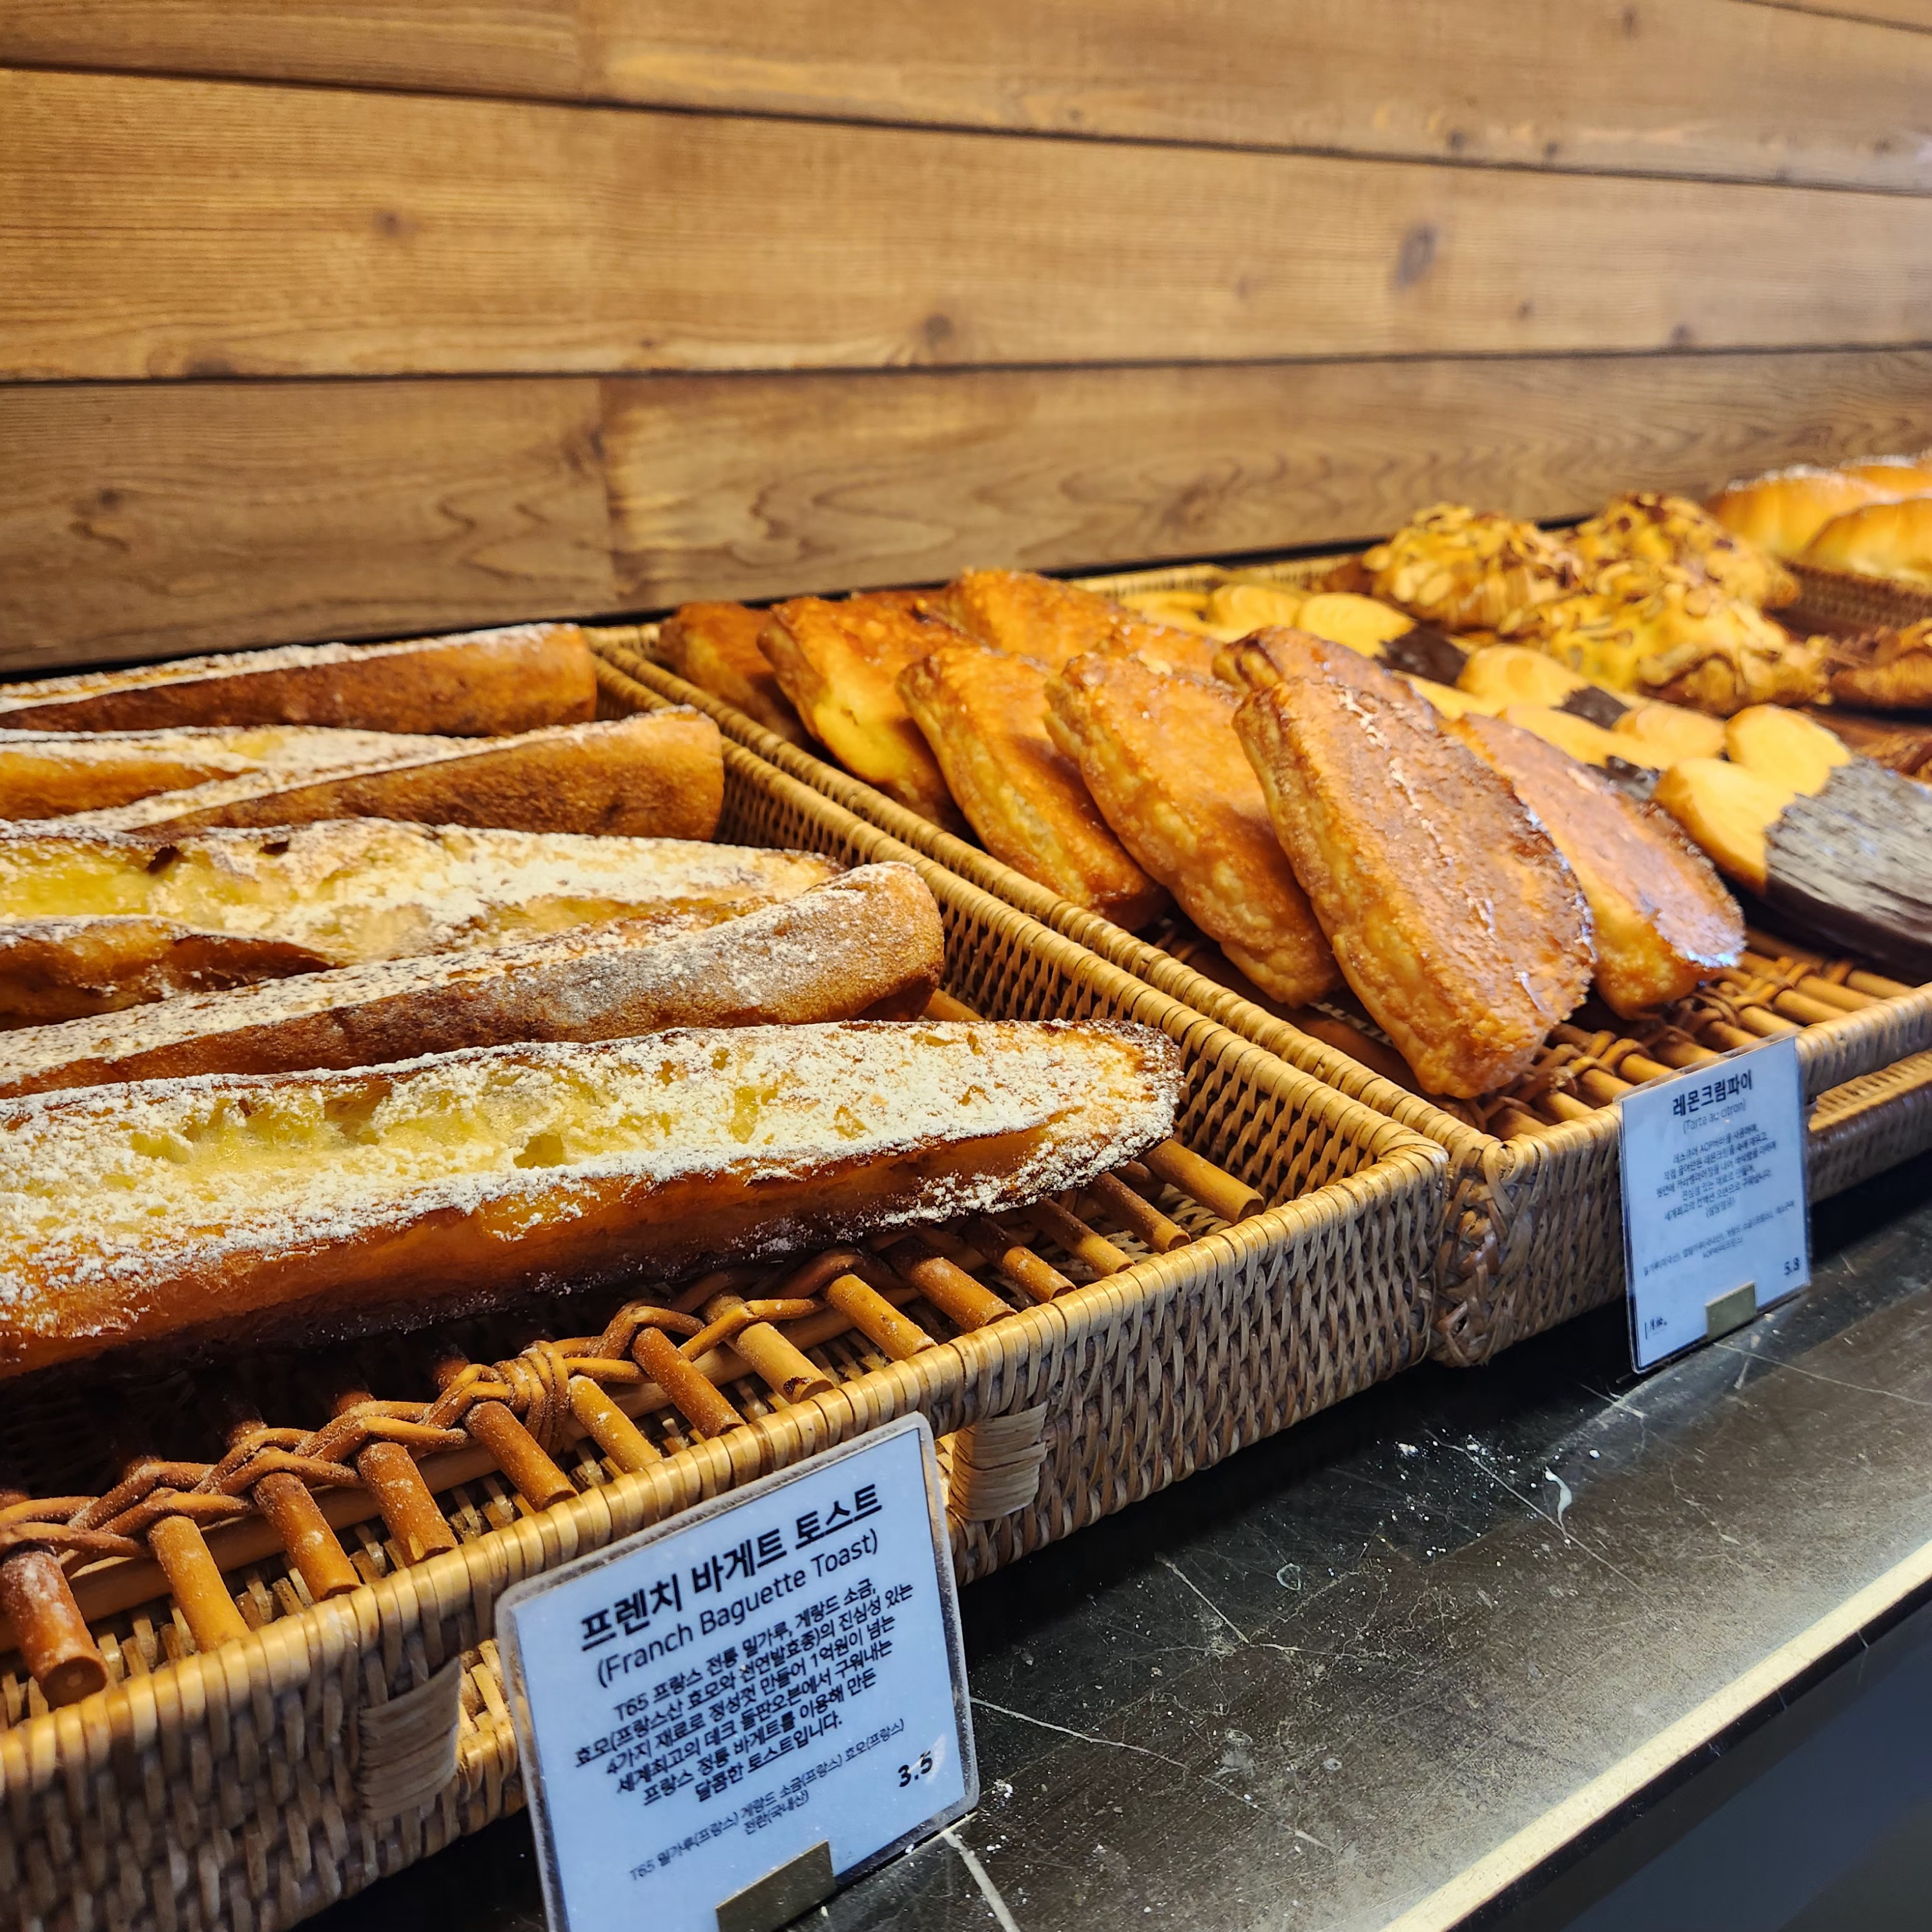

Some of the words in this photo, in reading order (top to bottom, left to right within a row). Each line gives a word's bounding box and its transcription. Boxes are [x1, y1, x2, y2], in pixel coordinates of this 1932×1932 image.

[1672, 1069, 1752, 1116] 레몬크림파이
[581, 1572, 683, 1652] 프렌치
[690, 1528, 787, 1594] 바게트
[795, 1483, 882, 1550] 토스트
[597, 1623, 694, 1688] (Franch
[699, 1569, 806, 1636] Baguette
[810, 1527, 878, 1577] Toast)
[575, 1698, 684, 1768] 효모(프랑스산
[686, 1670, 736, 1710] 효모와
[838, 1594, 881, 1632] 진심성
[884, 1583, 913, 1608] 있는
[606, 1738, 652, 1774] 4가지
[653, 1712, 706, 1748] 재료로
[759, 1656, 807, 1696] 만들어
[809, 1627, 863, 1667] 1억원이
[866, 1615, 896, 1641] 넘는
[613, 1692, 649, 1721] T65
[652, 1667, 703, 1703] 프랑스
[705, 1646, 739, 1677] 전통
[741, 1621, 793, 1659] 밀가루,
[794, 1594, 841, 1629] 게랑드
[843, 1577, 876, 1605] 소금,
[616, 1736, 701, 1793] 세계최고의
[703, 1719, 738, 1747] 데크
[739, 1667, 832, 1731] 돌판오븐에서
[834, 1639, 892, 1678] 구워내는
[643, 1769, 695, 1806] 프랑스
[732, 1710, 796, 1755] 바게트를
[799, 1683, 845, 1718] 이용해
[847, 1667, 876, 1696] 만든
[694, 1761, 744, 1802] 달콤한
[747, 1709, 842, 1773] 토스트입니다.
[779, 1753, 843, 1798] 소금(프랑스)
[844, 1718, 904, 1762] 효모(프랑스)
[898, 1750, 933, 1787] 3.5
